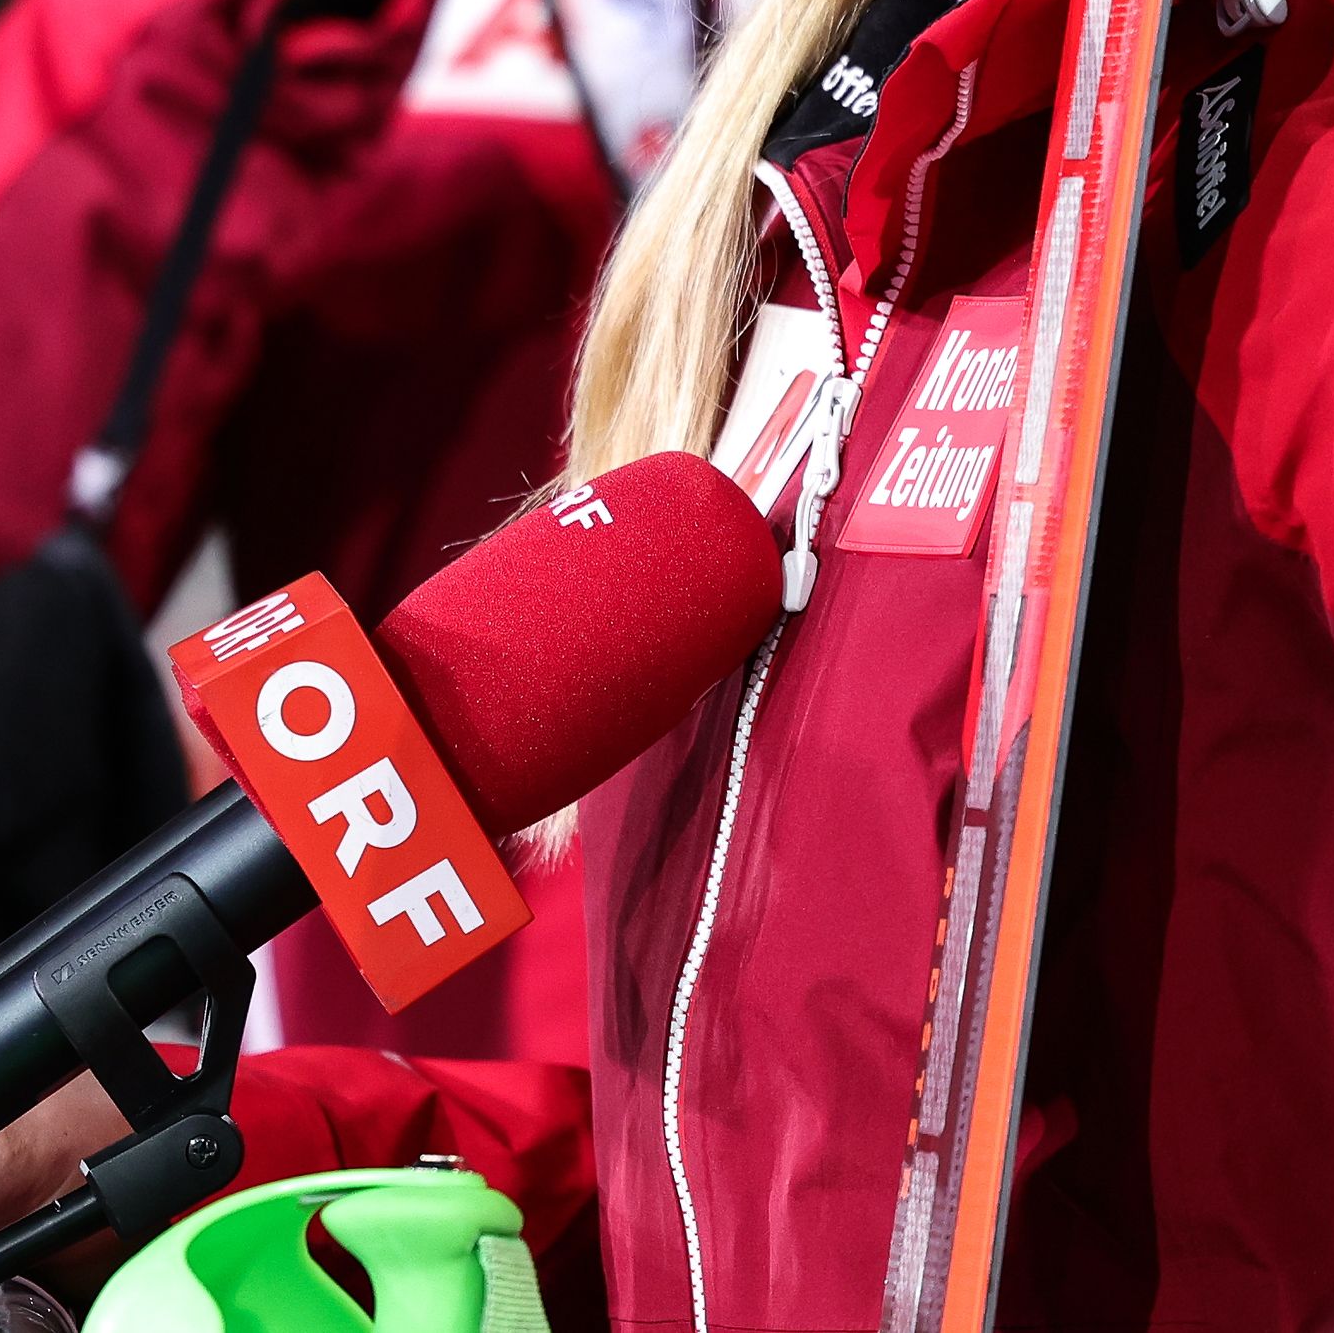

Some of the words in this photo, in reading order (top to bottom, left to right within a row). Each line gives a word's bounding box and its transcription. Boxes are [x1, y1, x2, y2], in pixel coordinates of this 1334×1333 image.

[548, 484, 614, 530] RF
[868, 424, 995, 522] Zeitung
[202, 592, 305, 662] ORF
[255, 659, 485, 947] ORF
[75, 890, 184, 967] SENNHEISER
